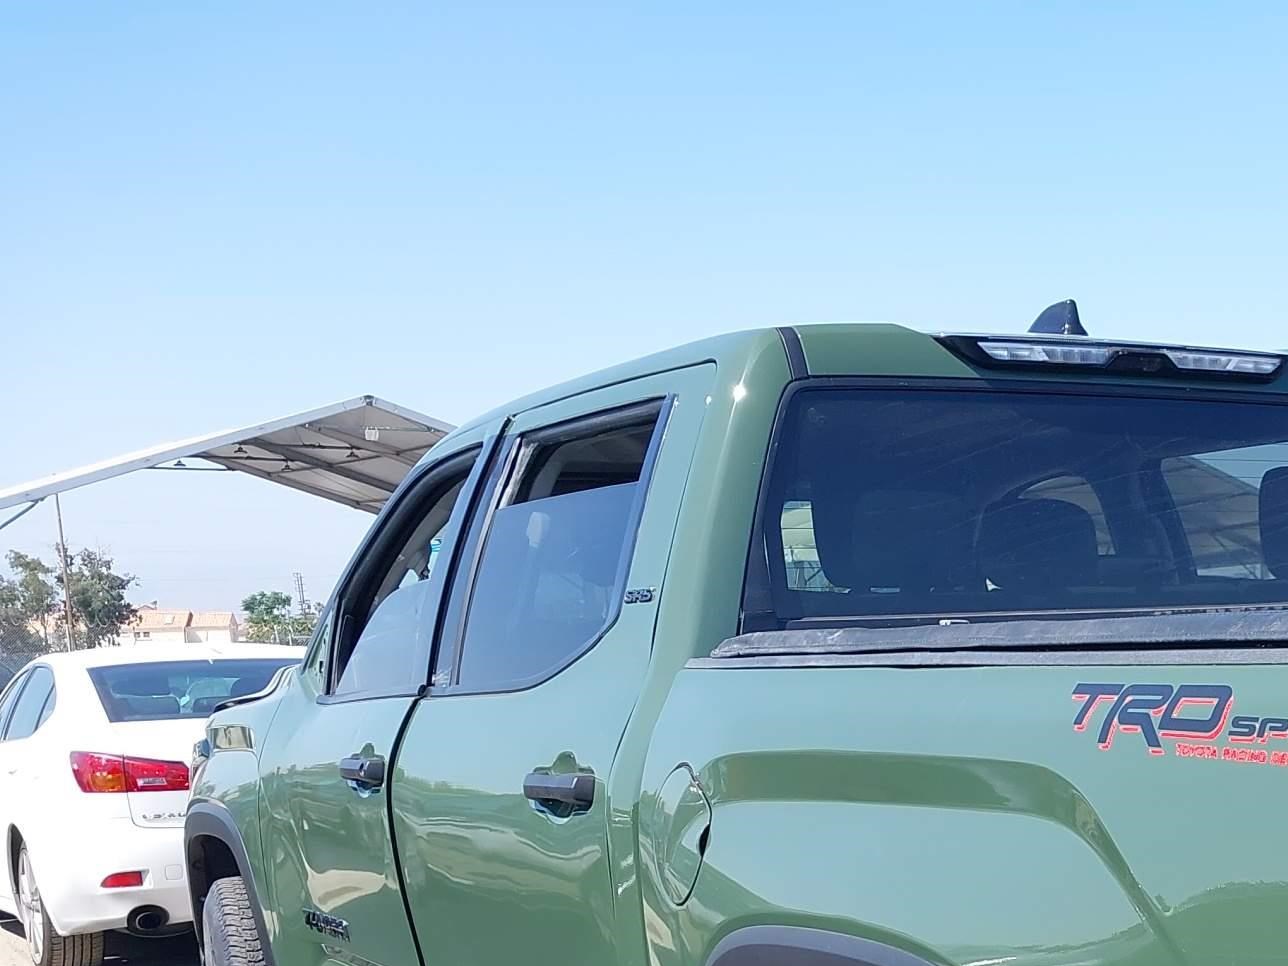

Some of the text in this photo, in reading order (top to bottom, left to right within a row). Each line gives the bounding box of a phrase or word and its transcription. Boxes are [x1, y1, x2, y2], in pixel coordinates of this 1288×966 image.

[1071, 683, 1235, 755] TRD
[1176, 743, 1218, 760] TOYOTA
[1222, 746, 1266, 764] RACING
